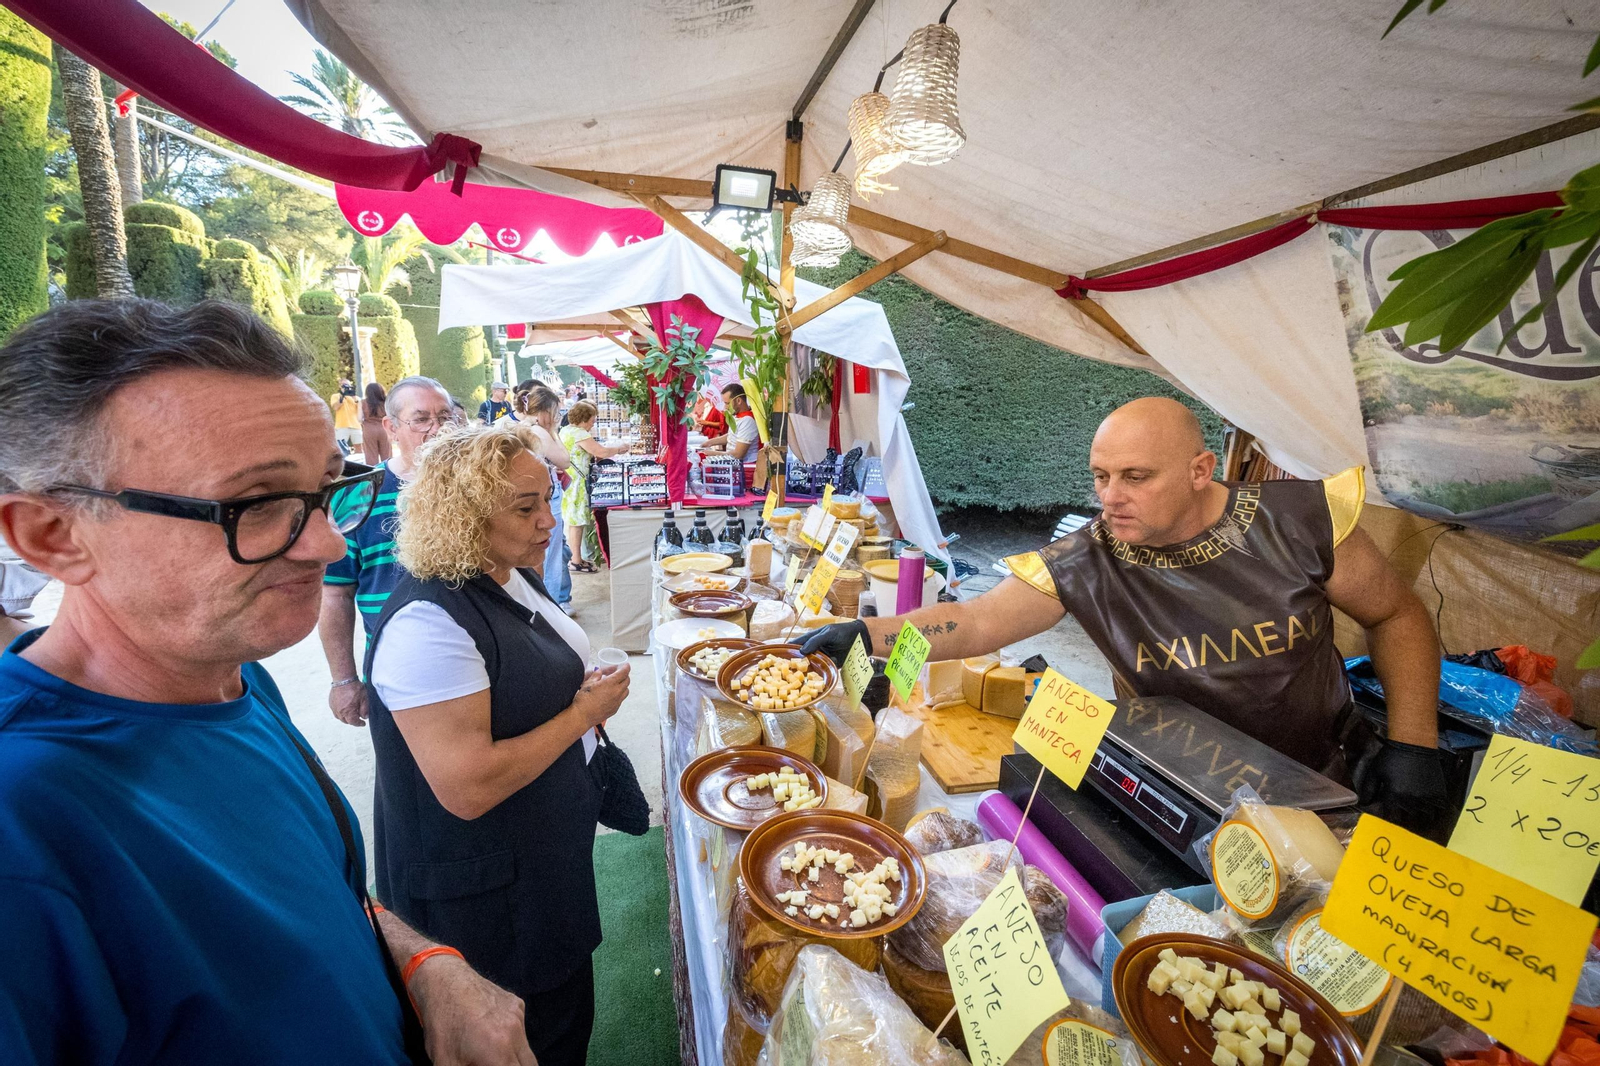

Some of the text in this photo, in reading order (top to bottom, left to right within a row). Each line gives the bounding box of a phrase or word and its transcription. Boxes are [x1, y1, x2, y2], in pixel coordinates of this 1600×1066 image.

[1043, 678, 1100, 718] AÑEJO
[1046, 706, 1068, 724] EN
[1490, 746, 1532, 784] 1/4
[1466, 796, 1488, 824] 2
[1372, 836, 1536, 926] QUESO DE
[984, 923, 1007, 959] EN
[996, 885, 1044, 986] AÑEJO
[1368, 874, 1558, 982] OVEJA LARGA
[1344, 950, 1359, 965] ARTES
[956, 964, 969, 987] LOS
[964, 994, 974, 1014] DE
[1420, 974, 1494, 1022] AÑOS)
